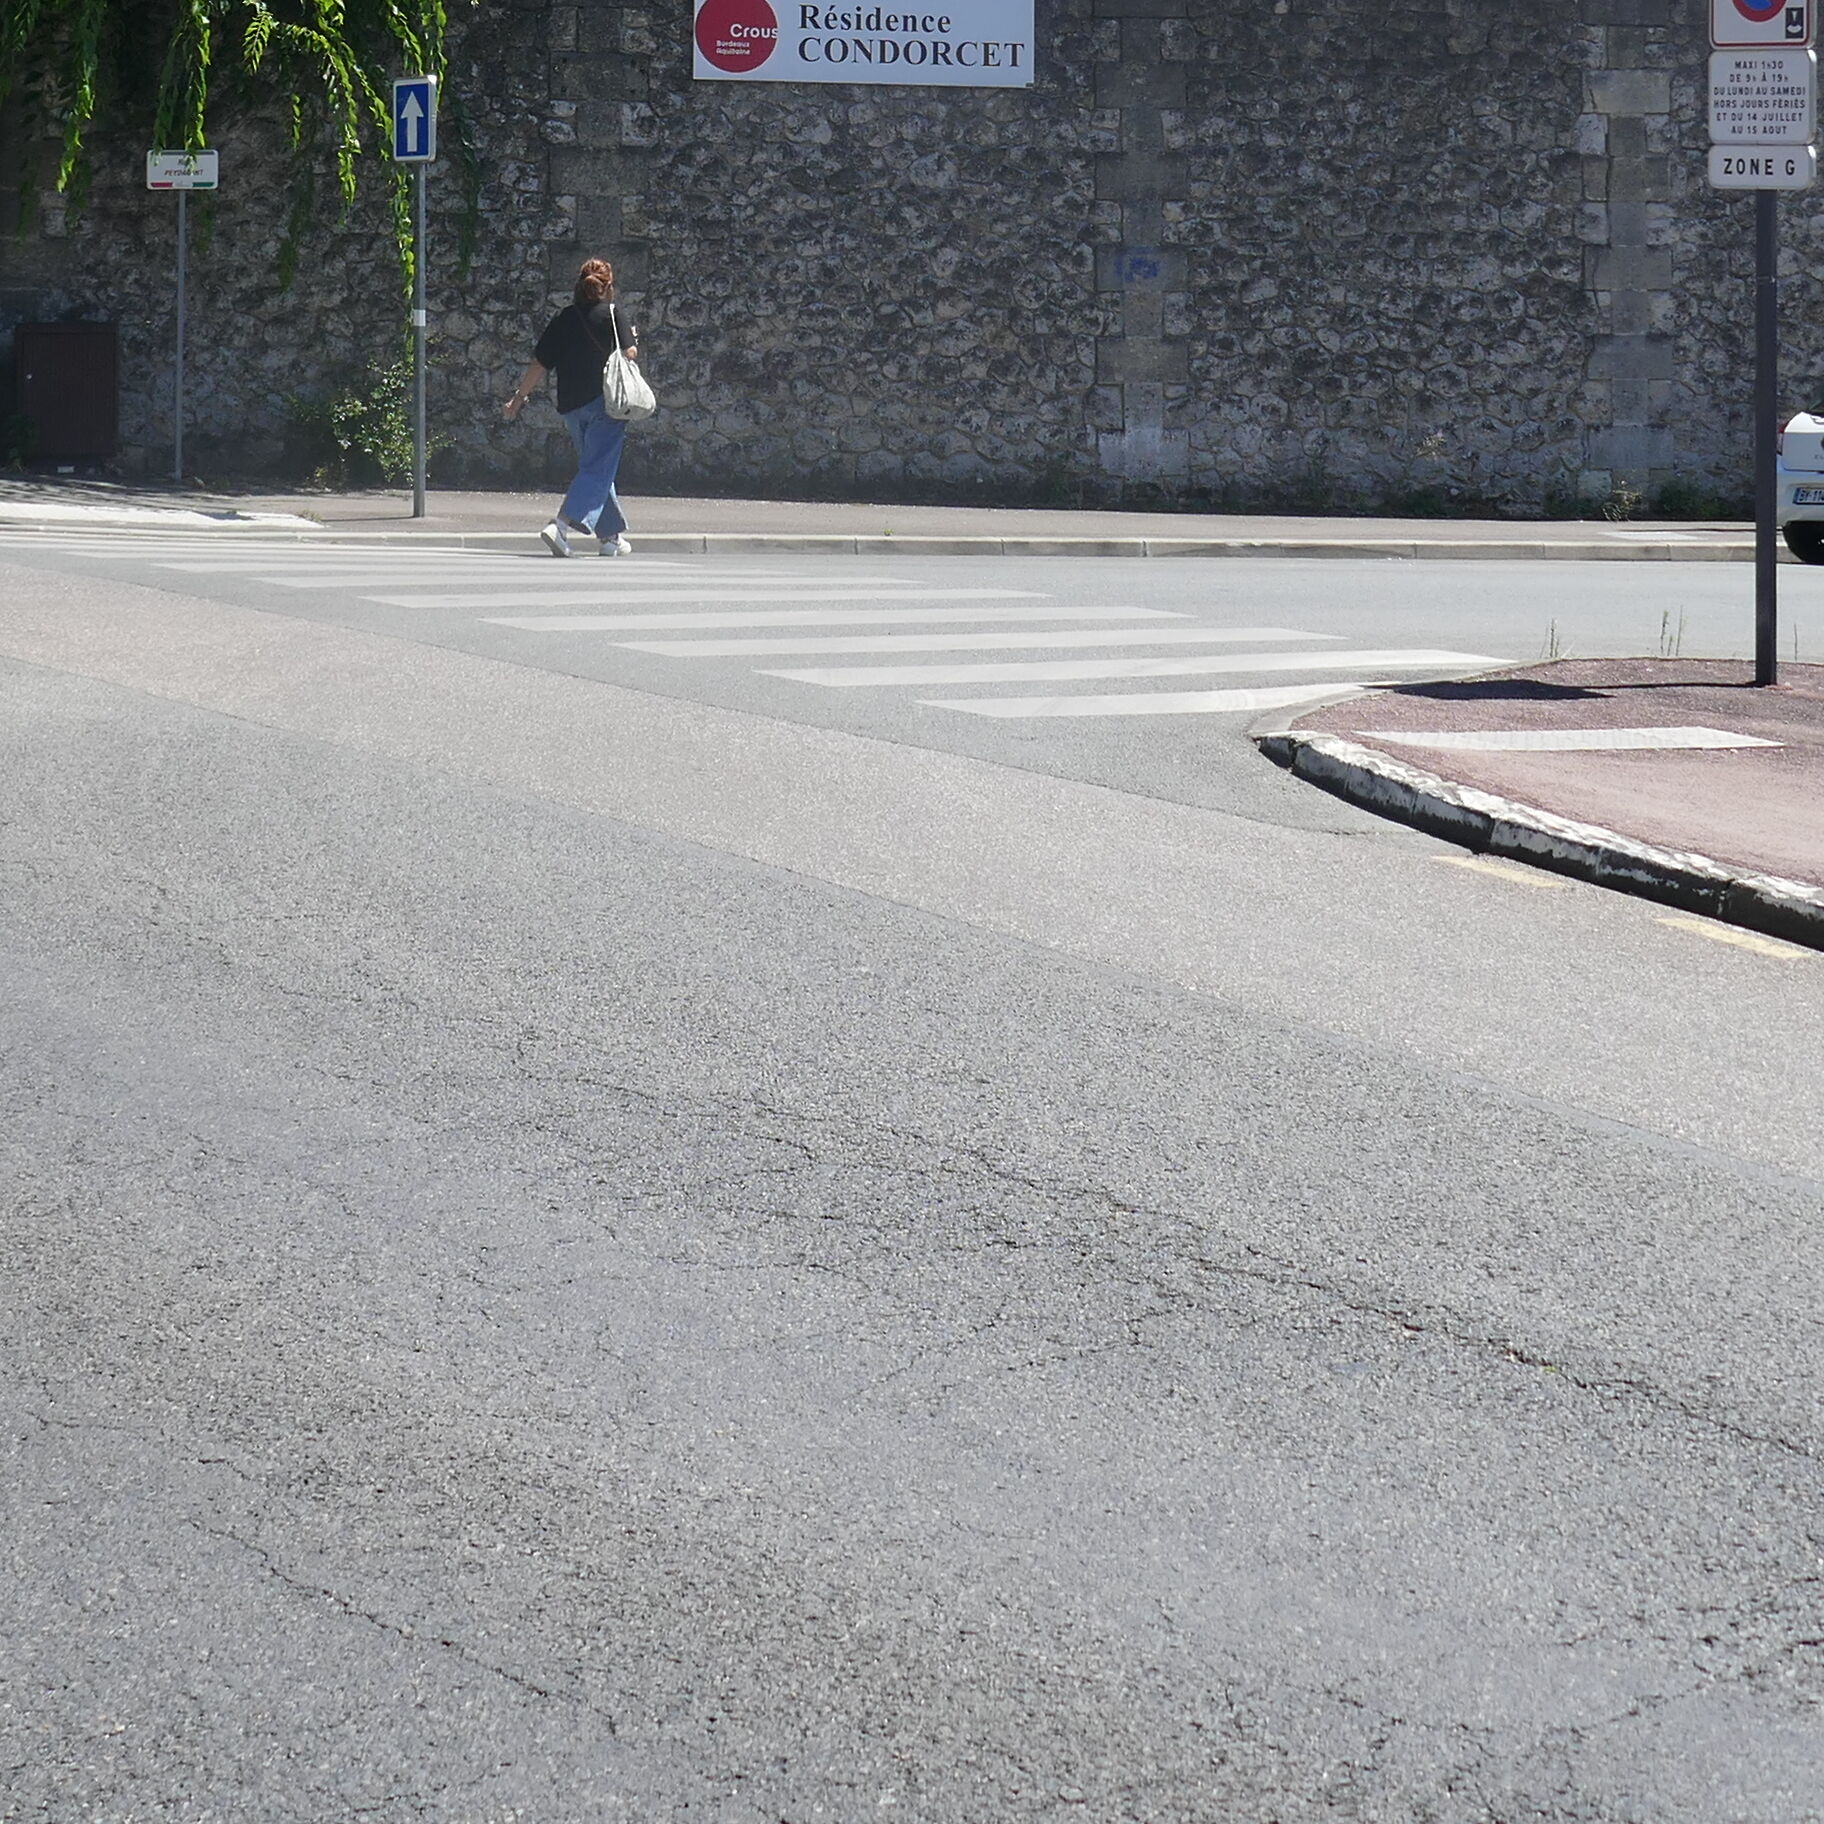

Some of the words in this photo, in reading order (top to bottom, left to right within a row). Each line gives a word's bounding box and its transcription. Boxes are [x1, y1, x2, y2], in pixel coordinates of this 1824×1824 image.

[798, 3, 952, 34] Résidence
[730, 23, 779, 39] Crous
[716, 40, 750, 48] Bordeaux
[798, 36, 1025, 68] CONDORCET
[1734, 60, 1758, 69] MAXI
[1729, 73, 1742, 83] DE
[1713, 86, 1726, 96] DU
[1727, 86, 1753, 96] LUNDI
[1756, 86, 1768, 96] AU
[1770, 86, 1806, 96] SAMEDI
[1713, 99, 1737, 109] HORS
[1740, 99, 1770, 109] JOURS
[1716, 112, 1727, 122] ET
[1731, 112, 1743, 122] DU
[1747, 112, 1757, 122] 14
[1761, 112, 1803, 122] JUILLET
[1731, 125, 1743, 135] AU
[1747, 125, 1757, 135] 15
[1762, 125, 1787, 135] AOUT
[1723, 157, 1774, 176] ZONE
[1785, 159, 1796, 176] G
